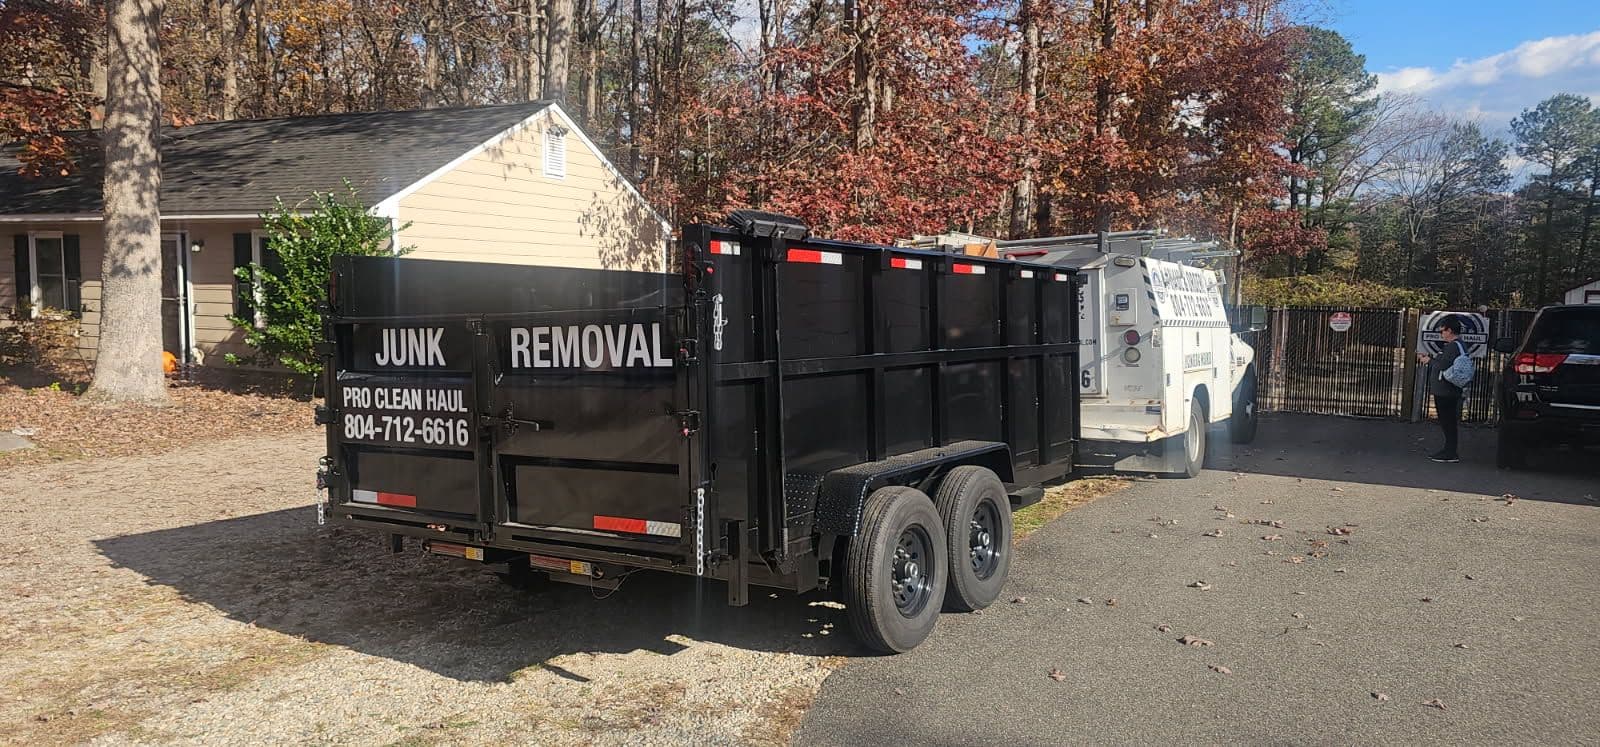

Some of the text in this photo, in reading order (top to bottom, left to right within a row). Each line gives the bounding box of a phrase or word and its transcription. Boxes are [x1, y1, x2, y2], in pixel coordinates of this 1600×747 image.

[375, 322, 673, 369] JUNK REMOVAL
[343, 386, 468, 413] PRO CLEAN HAUL
[344, 414, 469, 447] 804-712-6616
